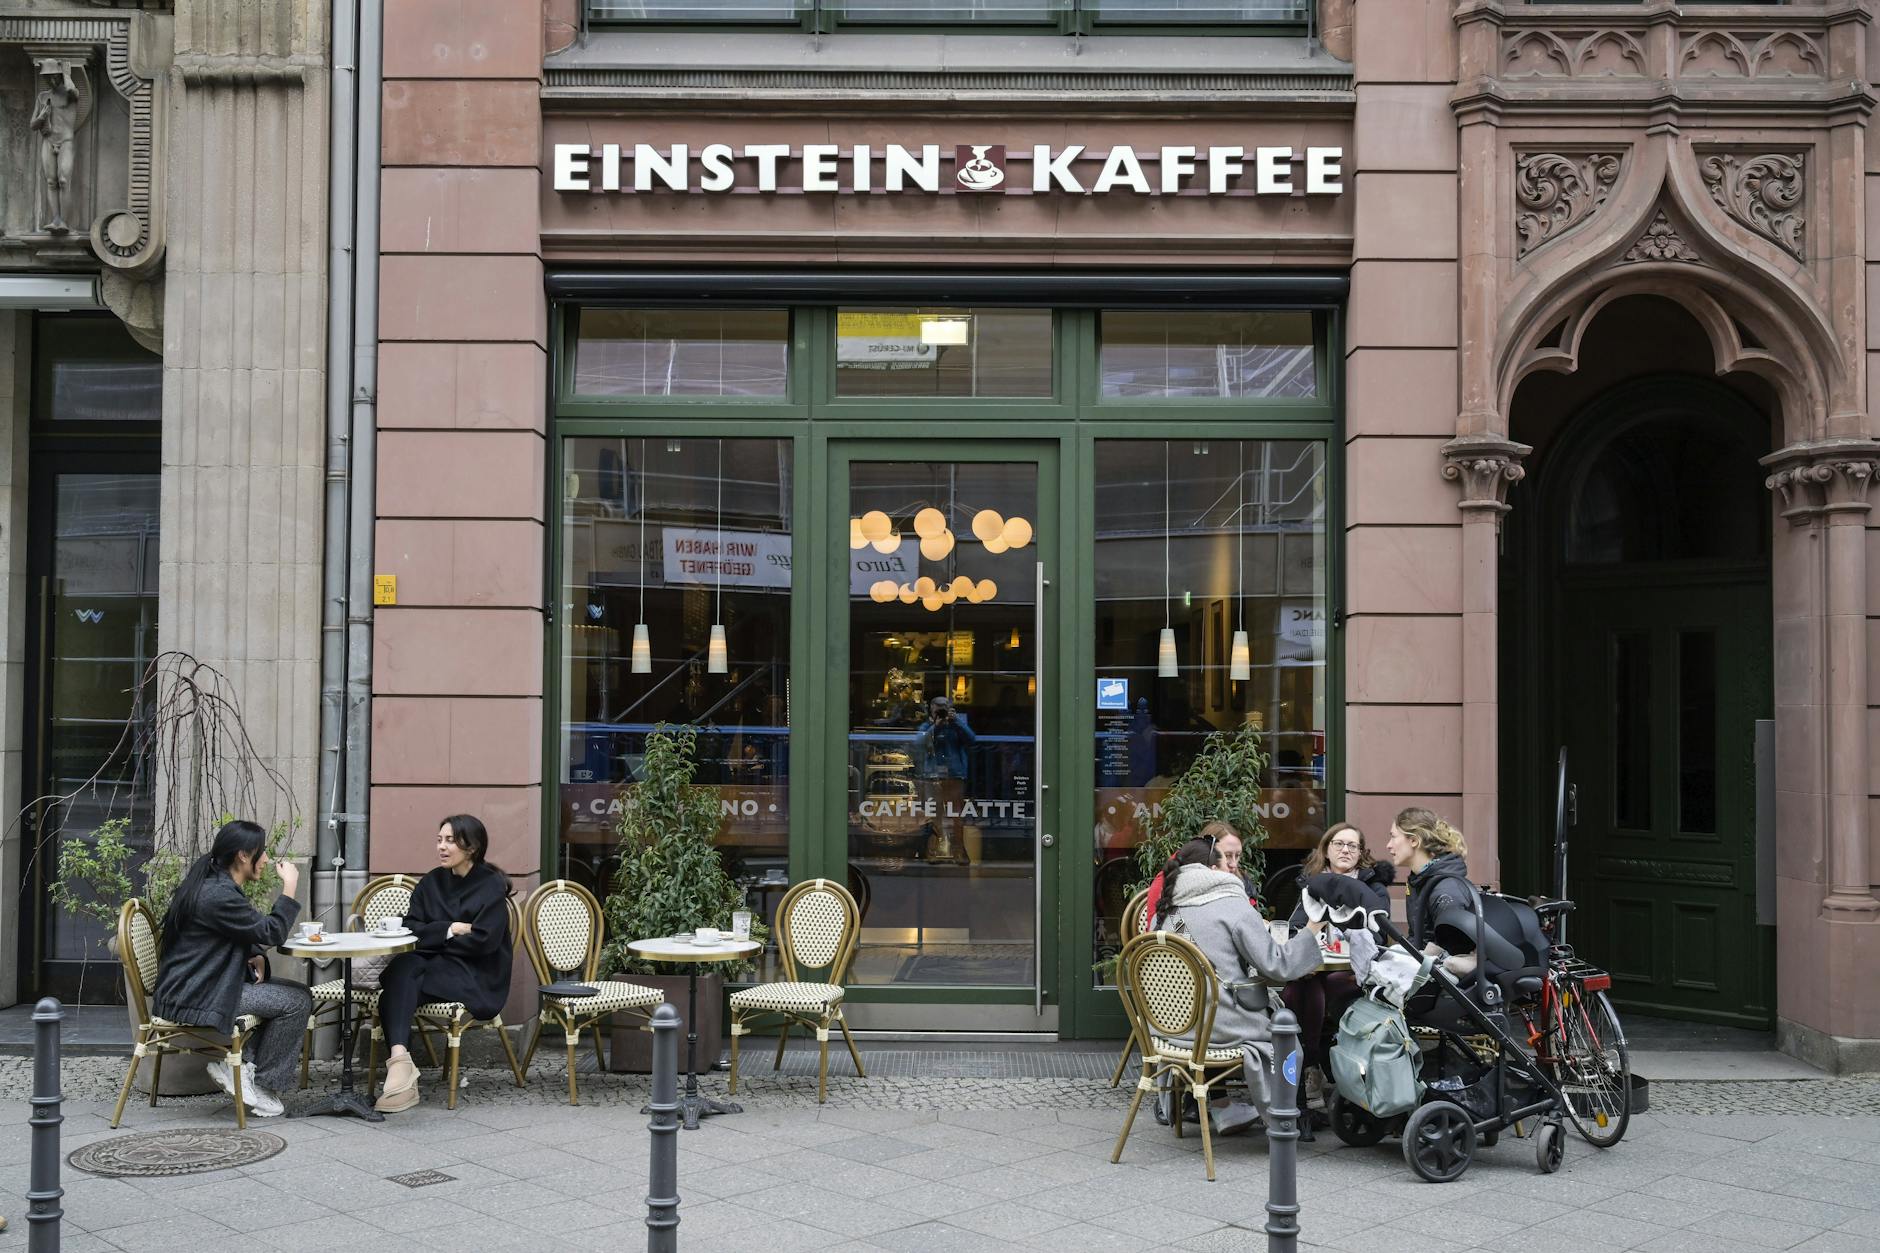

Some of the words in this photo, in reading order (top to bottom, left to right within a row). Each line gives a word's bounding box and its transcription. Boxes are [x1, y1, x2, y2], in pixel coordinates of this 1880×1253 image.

[553, 143, 940, 192] EINSTEIN
[1032, 144, 1343, 194] KAFFEE
[858, 797, 937, 818] CAFFÉ
[946, 801, 1026, 818] LATTE
